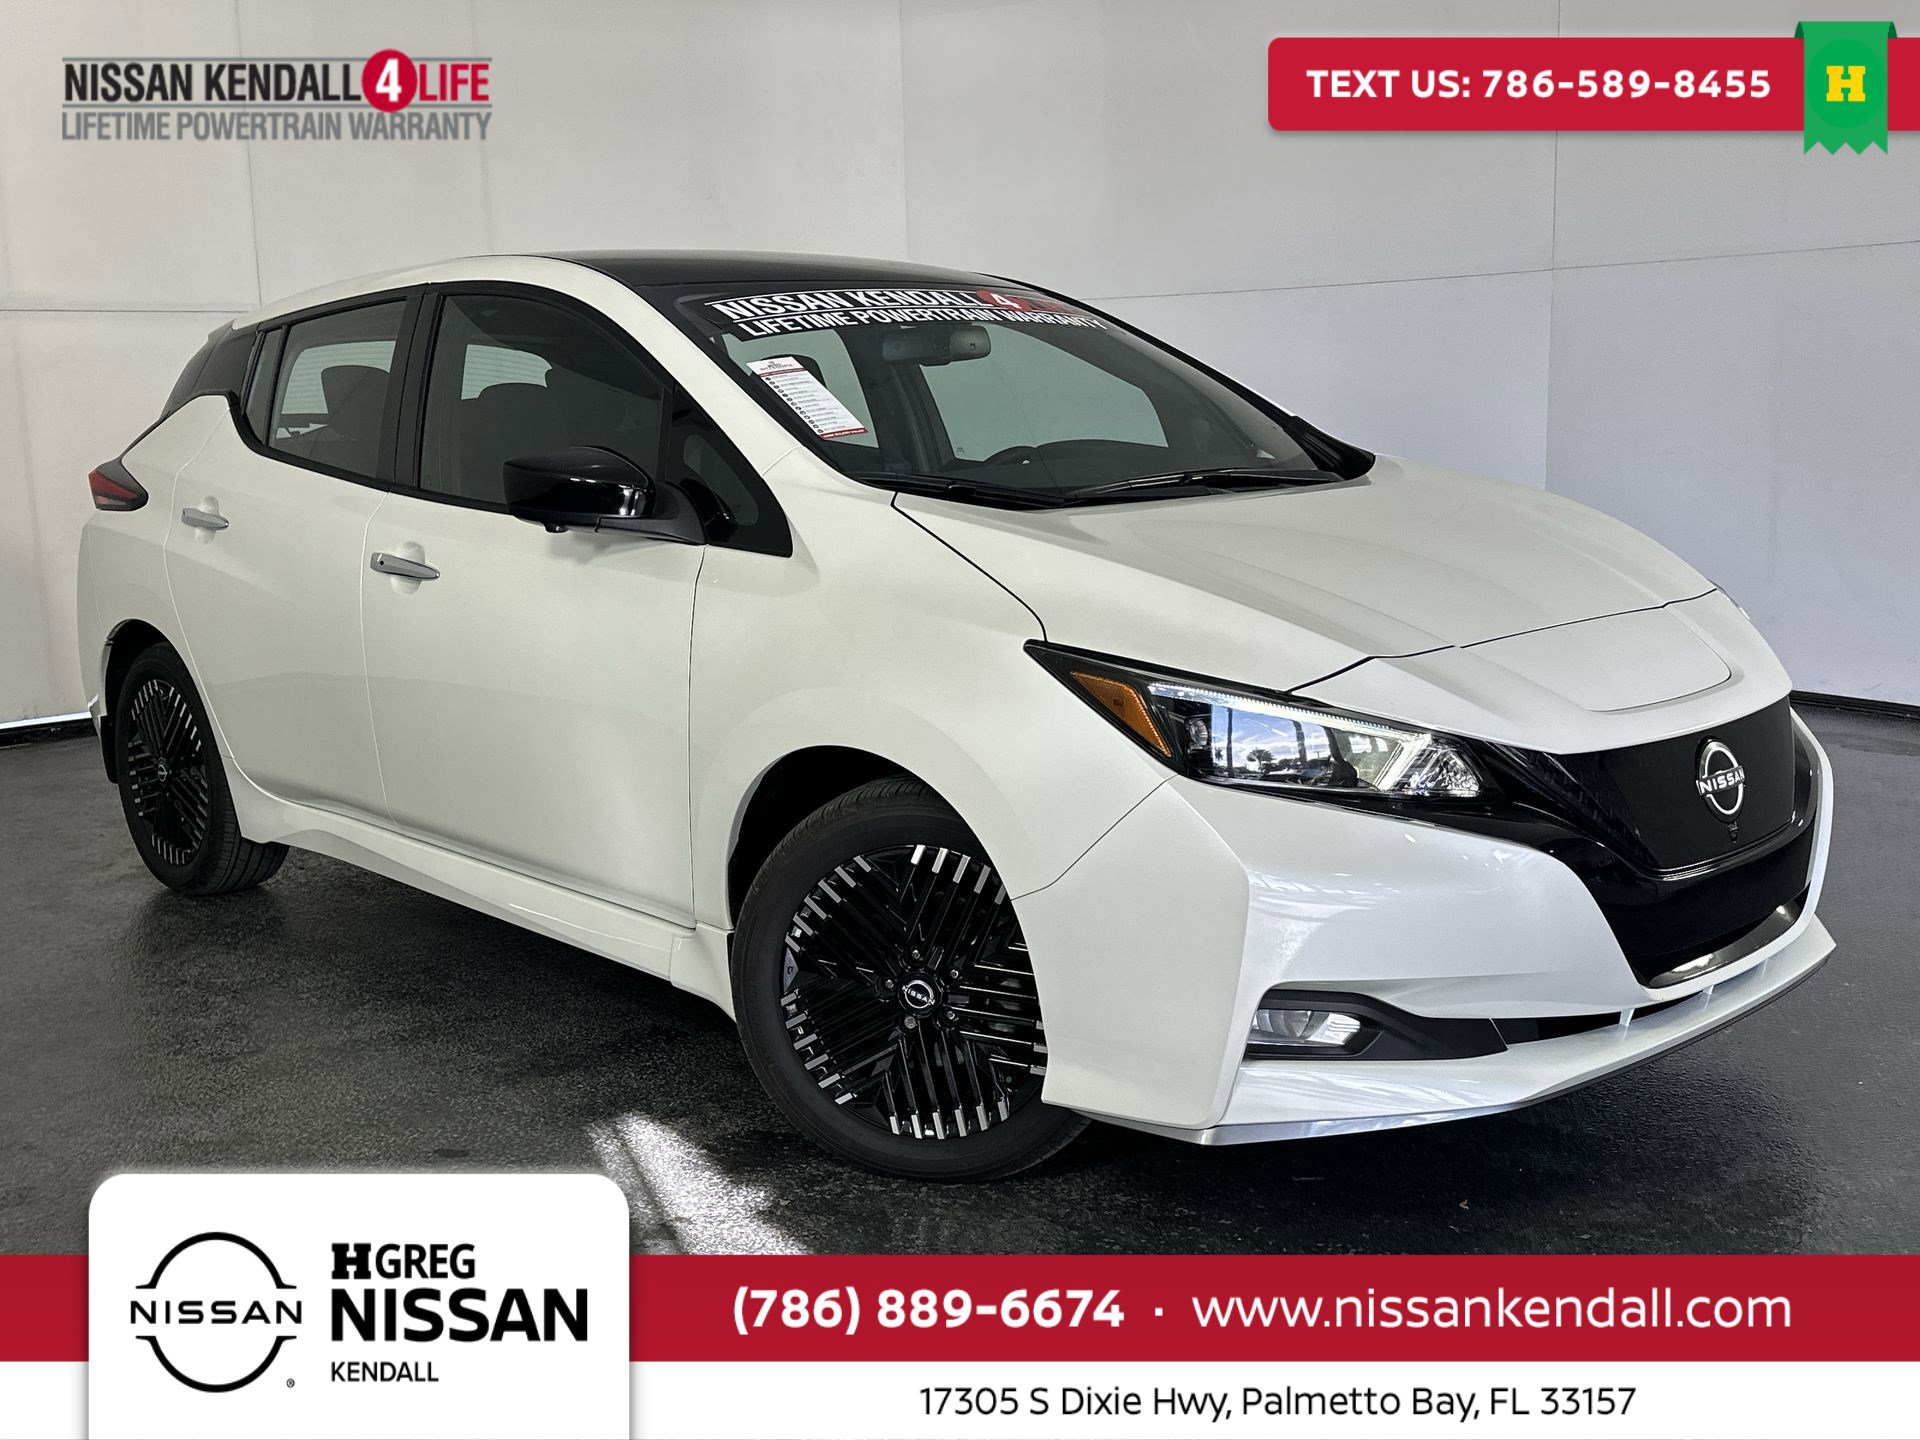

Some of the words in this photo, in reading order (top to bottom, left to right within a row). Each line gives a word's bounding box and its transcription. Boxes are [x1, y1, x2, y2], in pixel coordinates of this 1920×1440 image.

[711, 291, 850, 320] NISSAN
[849, 289, 994, 308] KENDALL
[738, 311, 858, 337] LIFETIME
[852, 308, 1003, 324] POWERTRAIN
[998, 310, 1107, 330] WARRANTY
[1700, 769, 1745, 794] NISSAN
[901, 984, 936, 1006] NISSAN
